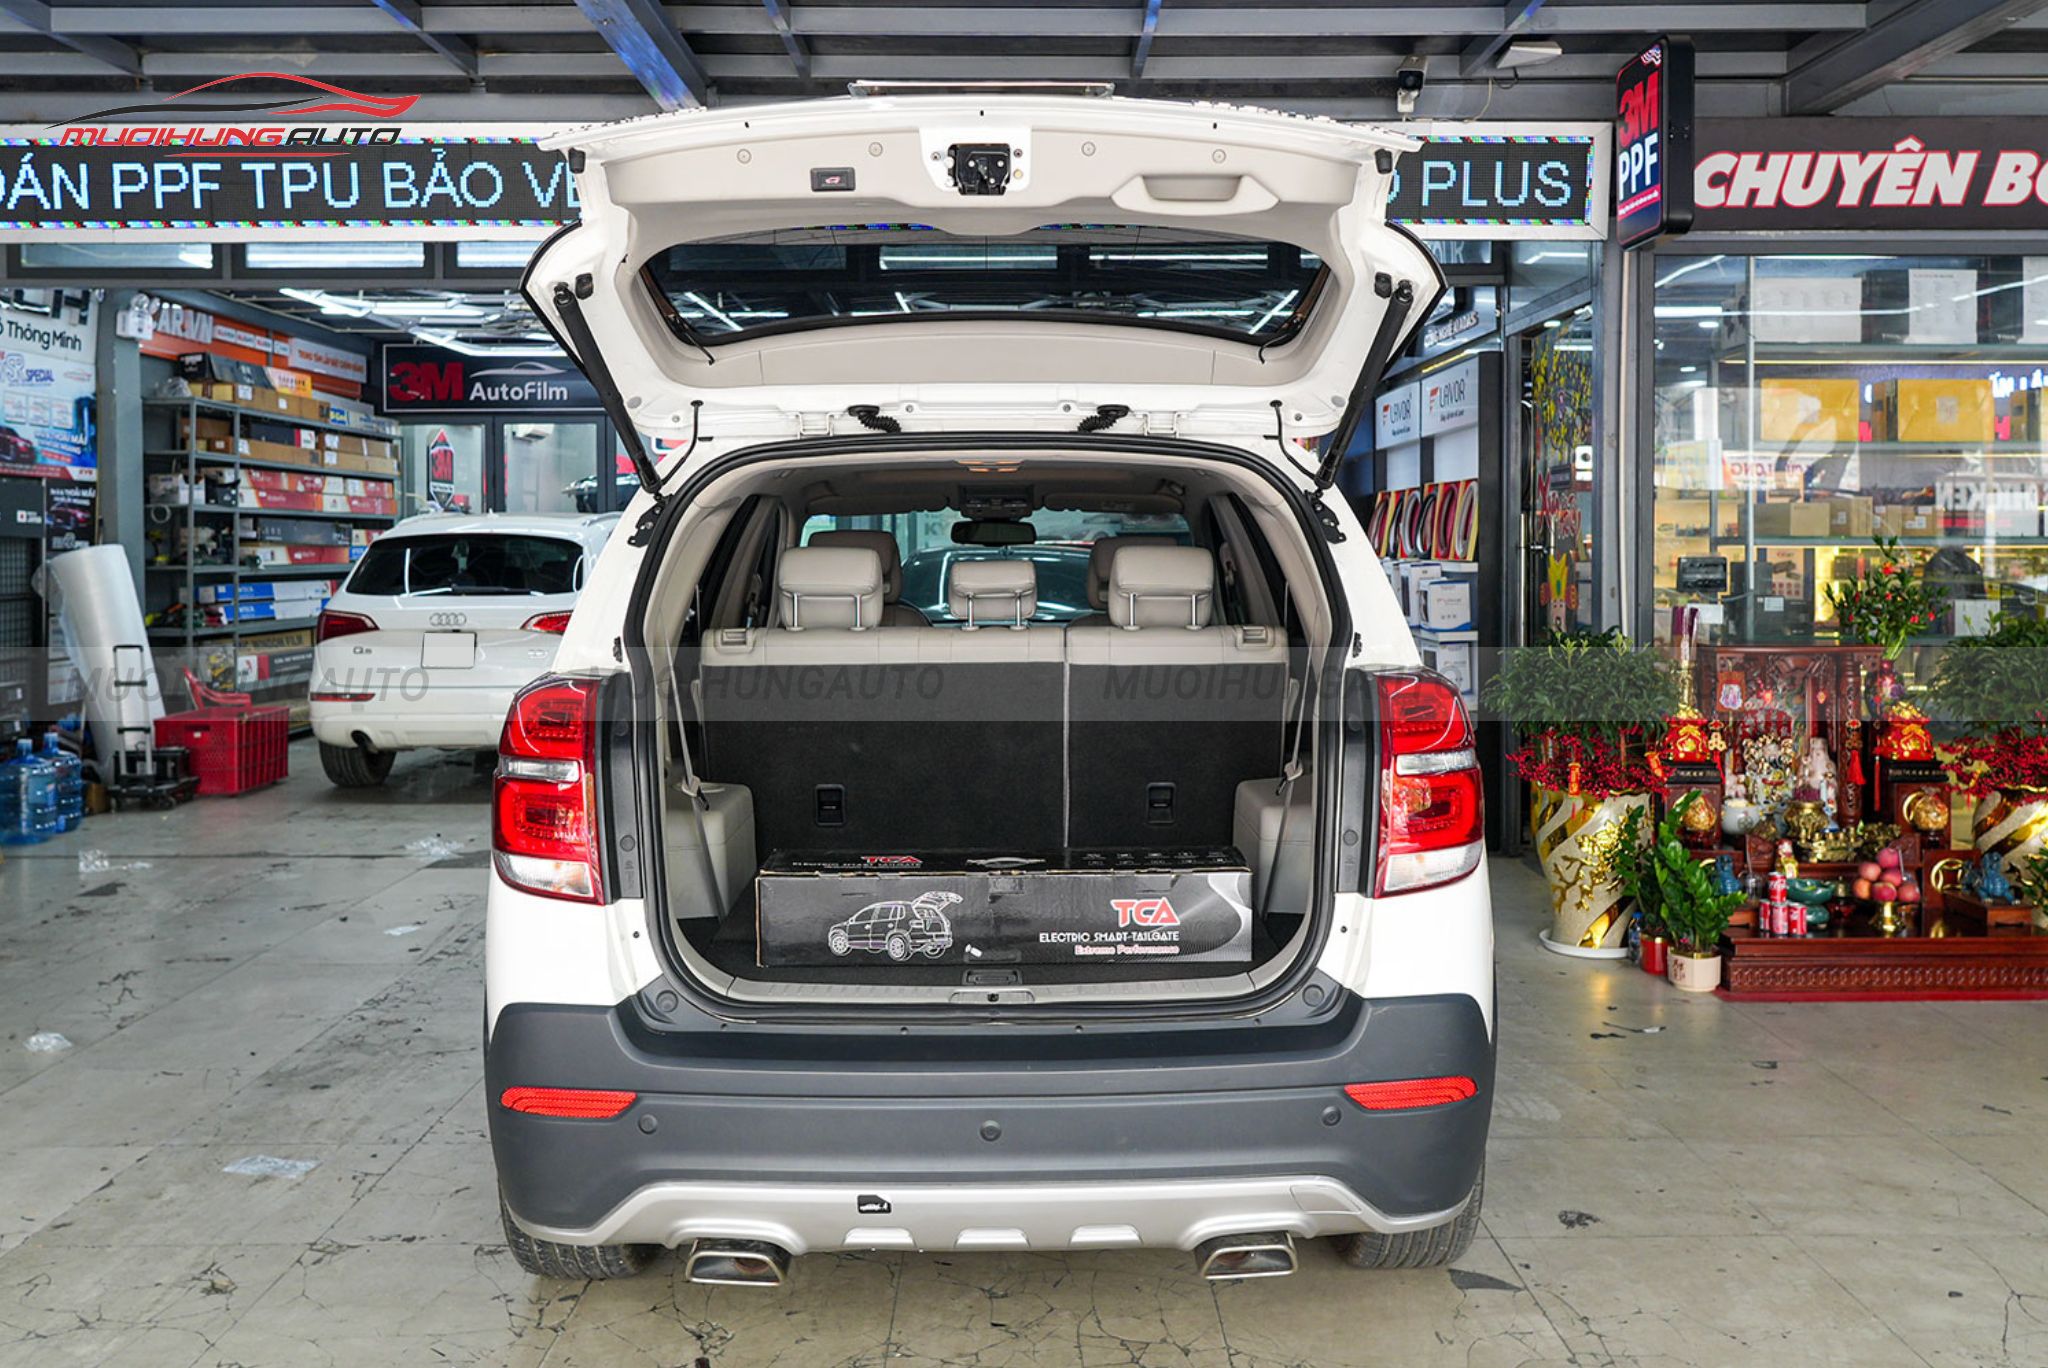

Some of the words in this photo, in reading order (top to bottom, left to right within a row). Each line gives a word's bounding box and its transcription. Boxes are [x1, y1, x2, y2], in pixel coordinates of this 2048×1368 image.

[1619, 72, 1660, 148] 3M
[0, 152, 90, 210] ÁN
[111, 162, 222, 210] PPF
[240, 162, 360, 209] TPU
[383, 148, 504, 209] BẢO
[1421, 160, 1572, 207] PLUS
[1618, 132, 1659, 202] PPF
[1694, 134, 1982, 208] CHUYÊN
[388, 361, 465, 402] 3M
[469, 381, 568, 401] AutoFilm
[431, 448, 453, 481] 3M
[1110, 897, 1180, 927] TCA
[1039, 932, 1090, 943] ELECTRIC
